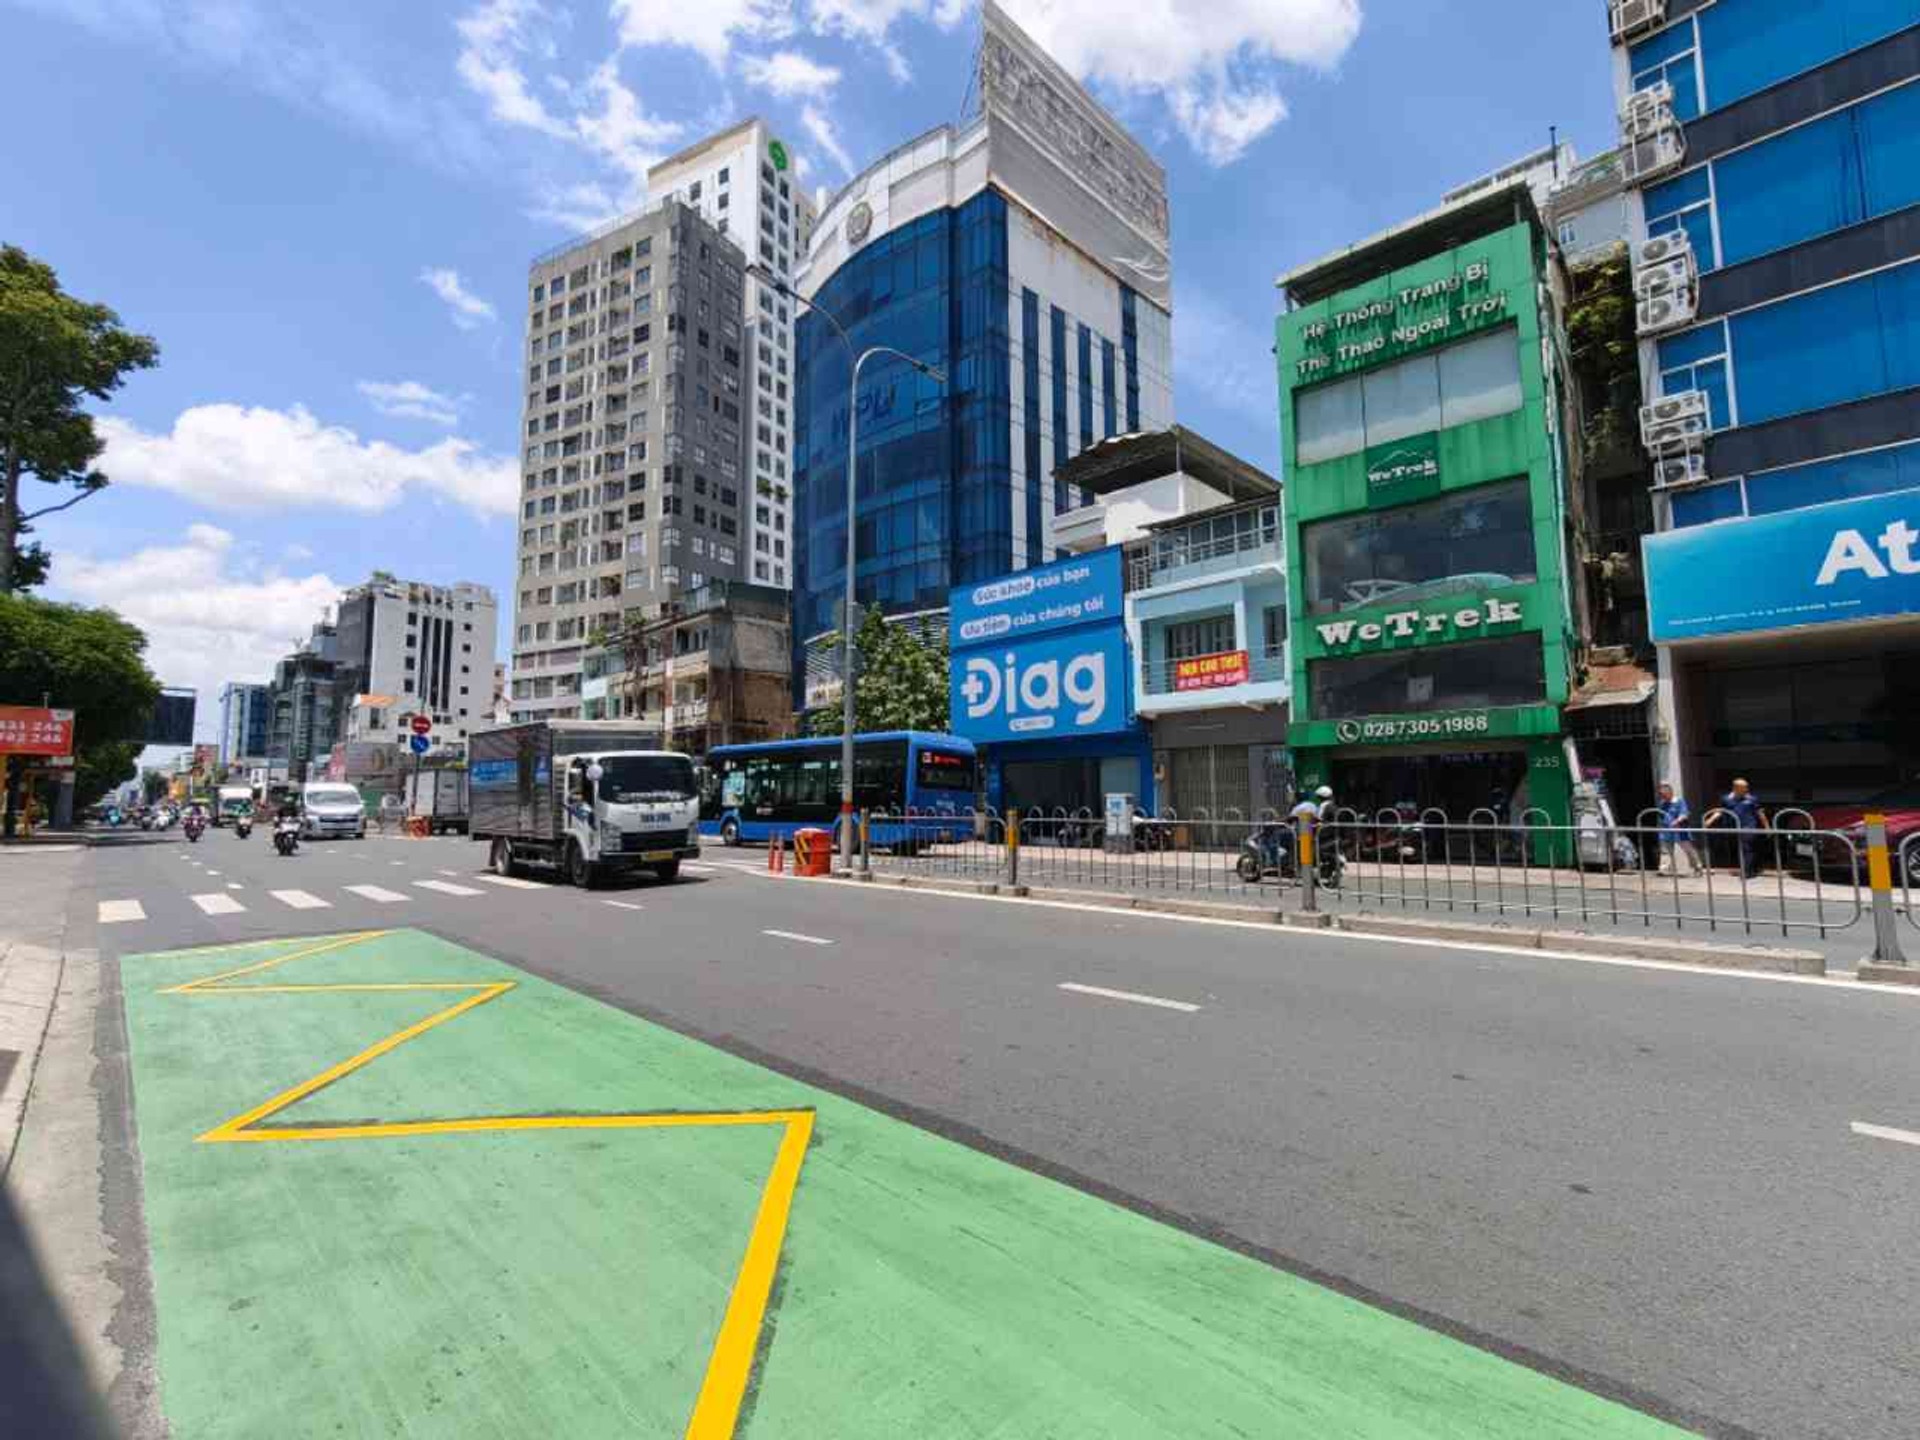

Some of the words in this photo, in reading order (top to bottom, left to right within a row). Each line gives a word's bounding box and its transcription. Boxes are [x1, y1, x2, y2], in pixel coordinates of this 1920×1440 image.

[1399, 273, 1461, 305] Trang
[1814, 519, 1920, 586] At
[1315, 598, 1523, 646] WeTrek
[1363, 715, 1488, 737] 02873051988
[1535, 755, 1560, 768] 235
